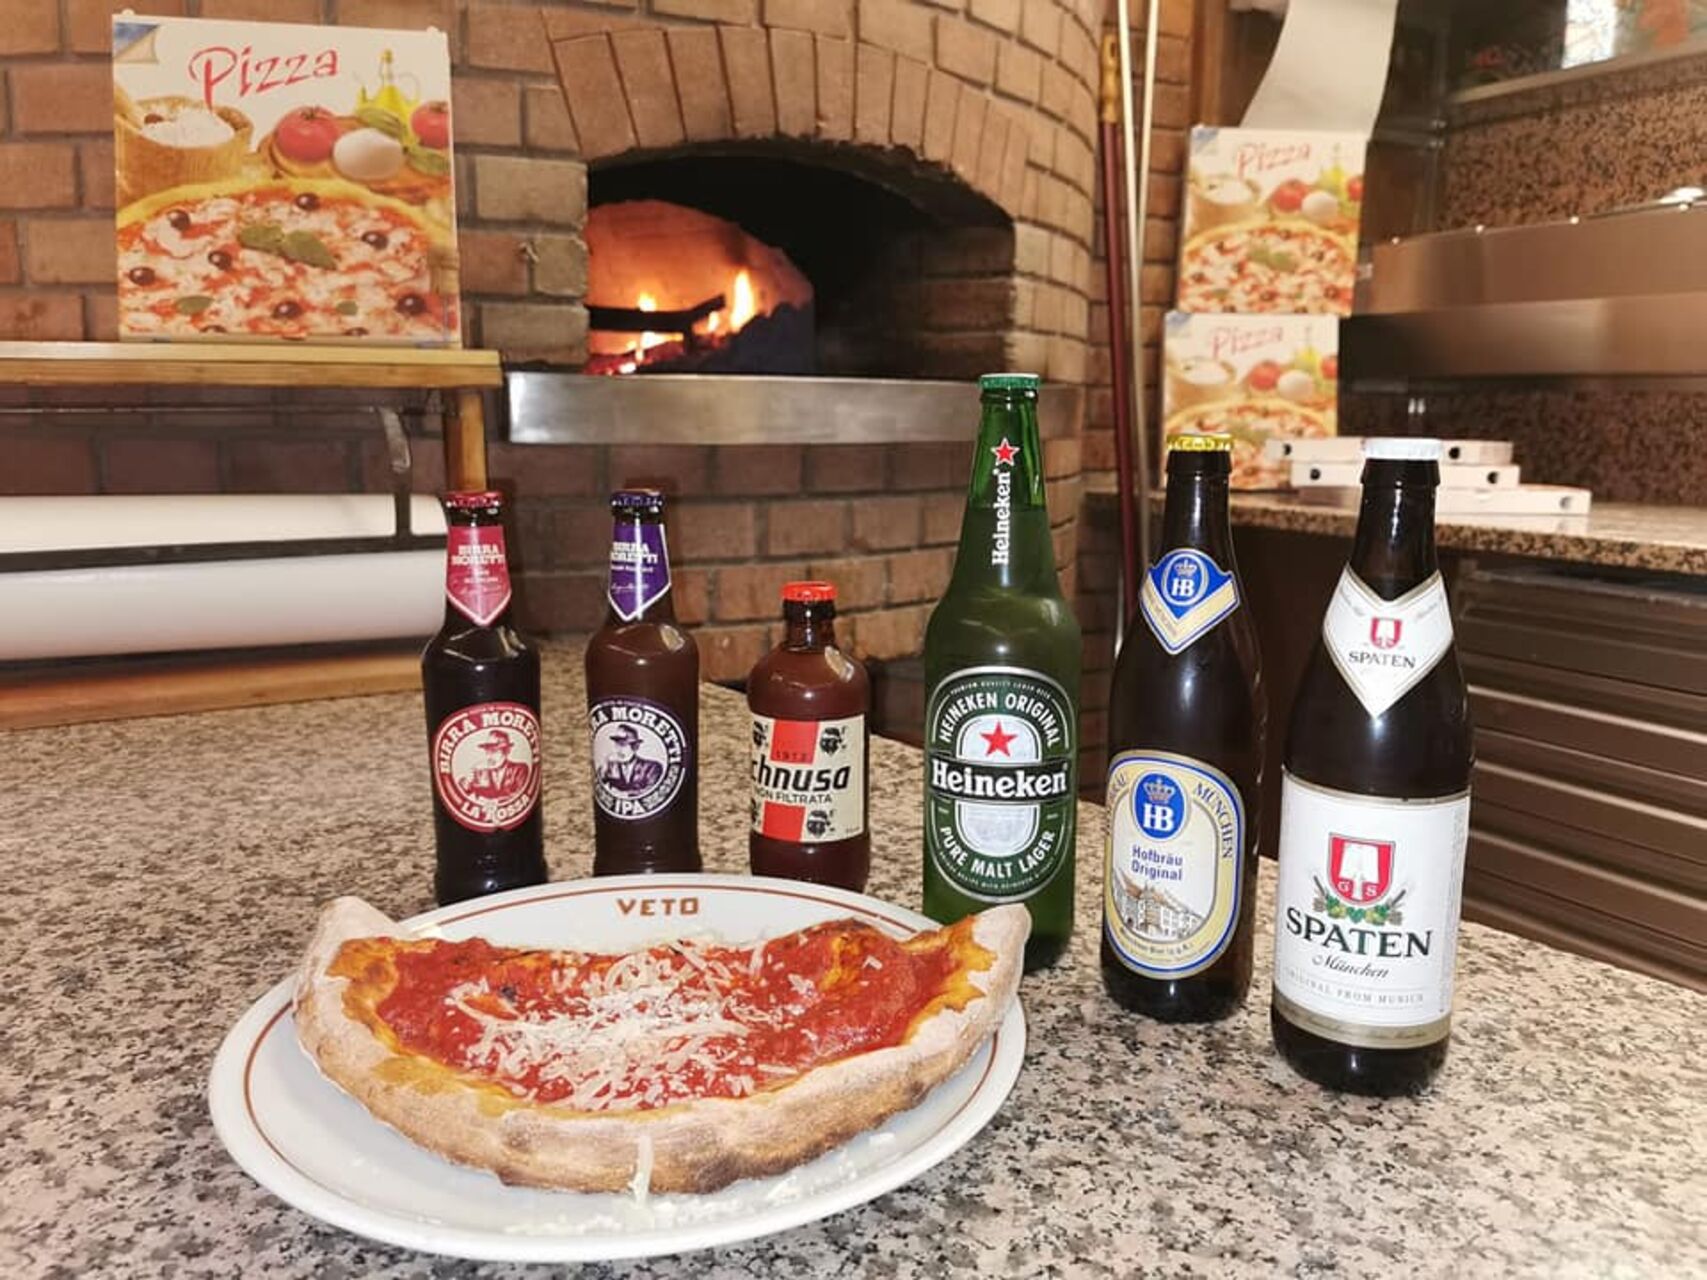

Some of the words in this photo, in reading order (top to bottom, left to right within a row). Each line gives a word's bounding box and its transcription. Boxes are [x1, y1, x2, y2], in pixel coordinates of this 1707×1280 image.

[188, 46, 338, 111] Pizza
[992, 470, 1010, 565] Heineken
[1171, 578, 1195, 597] HB
[1348, 651, 1416, 668] SPATEN
[611, 707, 681, 763] MORETTI
[939, 692, 997, 743] HEINEKEN
[1005, 692, 1060, 747] ORIGINAL
[440, 719, 477, 773] BIRRA
[752, 754, 851, 792] chnusa
[932, 759, 1067, 798] Heineken
[461, 801, 480, 819] LA
[615, 799, 646, 816] IPA
[776, 790, 832, 804] FILTRATA
[1143, 803, 1175, 832] HB
[940, 826, 968, 866] PURE
[970, 858, 1013, 878] MALT
[1018, 831, 1056, 873] LAGER
[1131, 860, 1183, 881] Original
[617, 898, 699, 916] VETO
[1286, 906, 1433, 958] SPATEN
[1311, 953, 1390, 979] München
